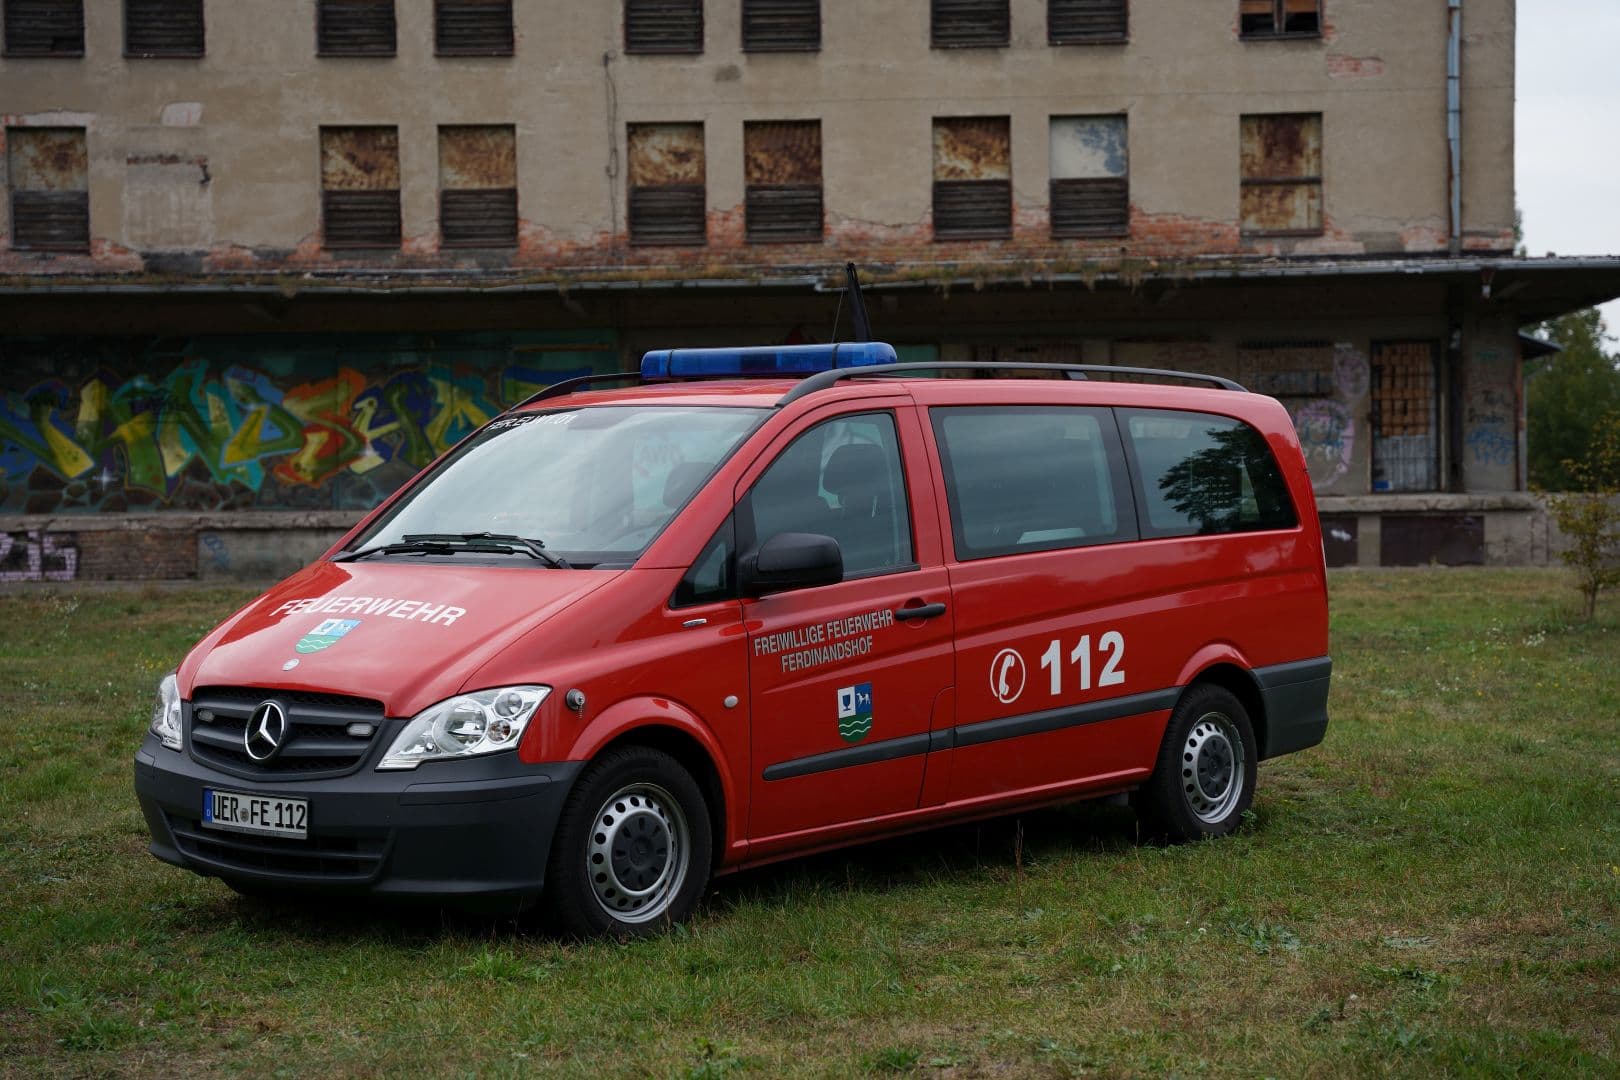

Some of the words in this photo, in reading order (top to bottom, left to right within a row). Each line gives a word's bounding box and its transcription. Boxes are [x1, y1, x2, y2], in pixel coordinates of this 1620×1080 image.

[269, 596, 467, 626] FEUERWEHR
[754, 624, 825, 656] FREIWILLIGE
[826, 608, 894, 641] FEUERWEHR
[781, 635, 873, 673] FERDINANDSHOF
[1041, 630, 1125, 695] 112
[212, 794, 239, 823] UER
[250, 799, 270, 827] FE
[274, 802, 306, 830] 112
